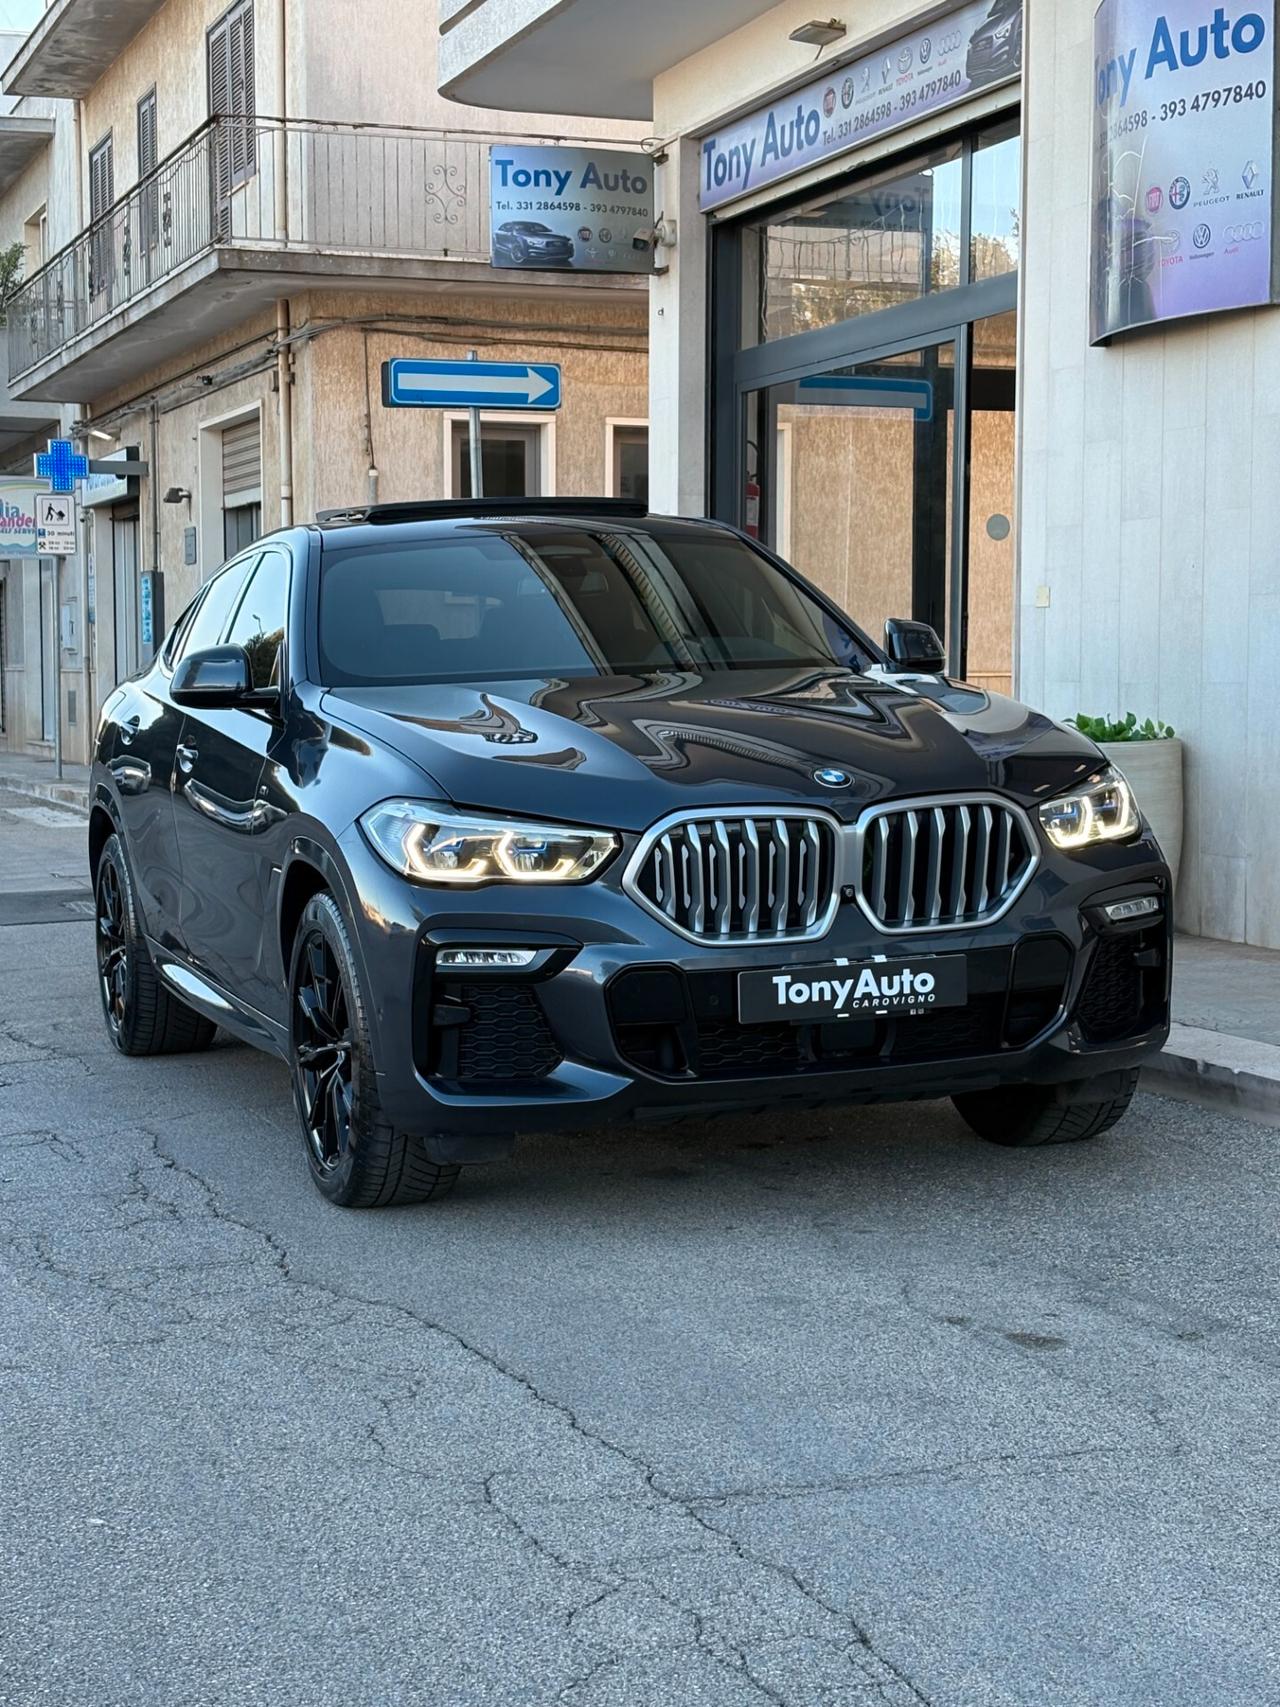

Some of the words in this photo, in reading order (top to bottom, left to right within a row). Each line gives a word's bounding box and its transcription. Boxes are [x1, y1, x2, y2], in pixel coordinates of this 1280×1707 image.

[1095, 47, 1137, 108] ony
[1144, 7, 1265, 80] Auto
[823, 130, 835, 145] Tel.
[838, 122, 851, 140] 331
[854, 102, 892, 132] 2864598
[900, 90, 917, 112] 393
[918, 70, 961, 104] 4797840
[1160, 98, 1186, 121] 393
[1190, 80, 1266, 112] 4797840
[703, 138, 756, 191] Tony
[760, 103, 821, 168] Auto
[495, 159, 573, 196] Tony
[580, 162, 648, 194] Auto
[496, 201, 513, 211] Tel.
[516, 201, 533, 211] 331
[536, 202, 581, 212] 2864598
[590, 203, 607, 213] 393
[609, 205, 648, 217] 4797840
[1193, 195, 1230, 207] PEUGEOT
[1236, 189, 1264, 200] RENAULT
[853, 993, 936, 1009] CAROVIGNO
